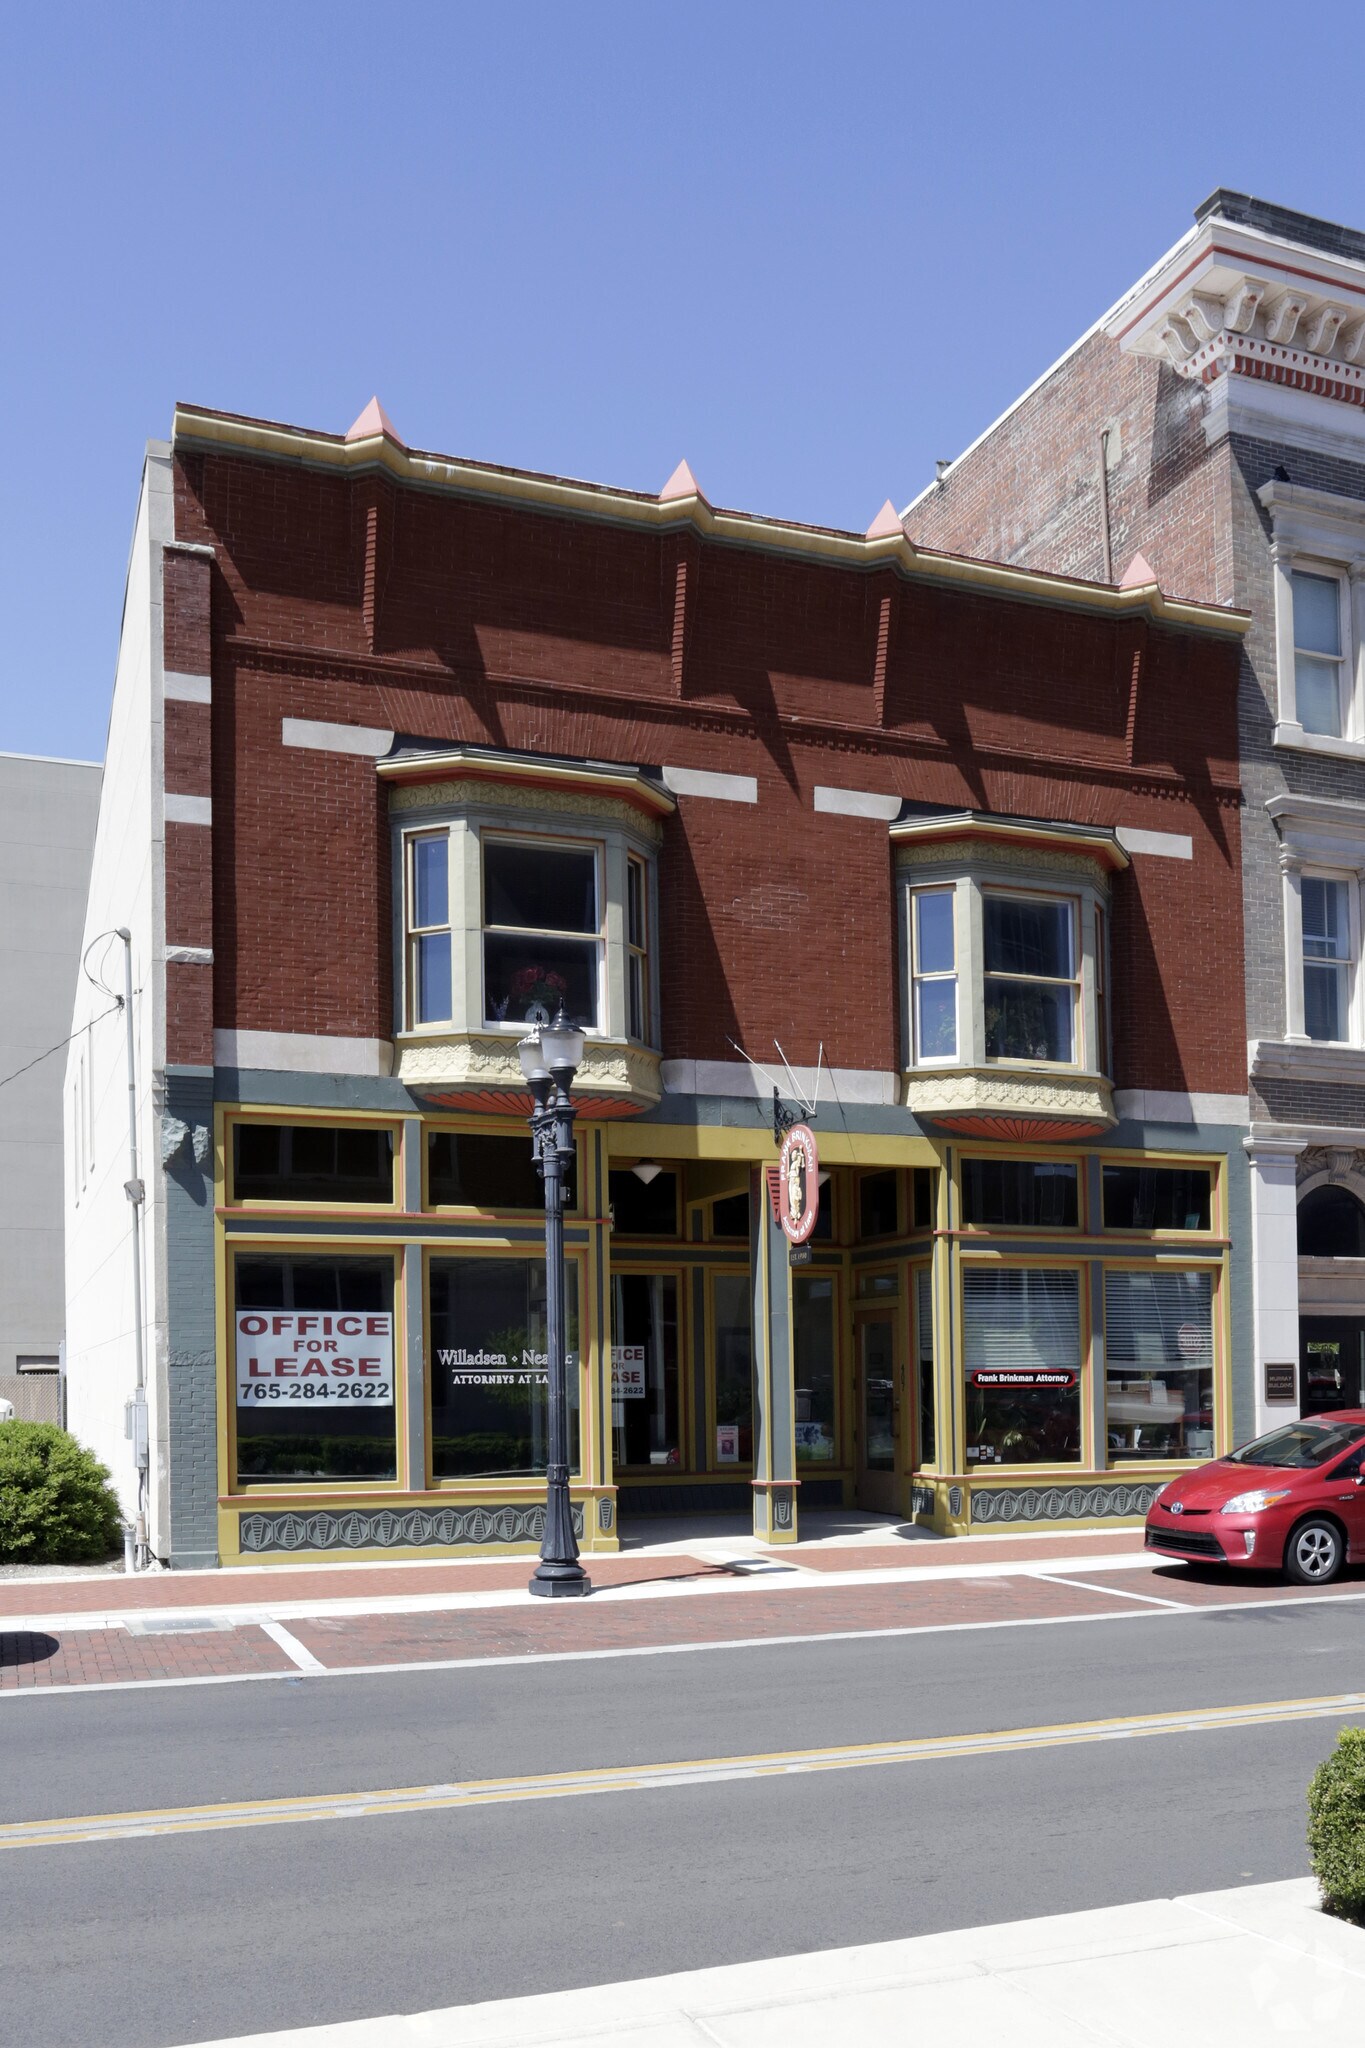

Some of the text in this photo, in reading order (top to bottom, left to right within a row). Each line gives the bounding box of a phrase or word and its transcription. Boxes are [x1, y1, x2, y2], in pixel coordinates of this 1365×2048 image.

[781, 1138, 791, 1180] FRANK
[239, 1316, 389, 1336] OFFICE
[293, 1340, 338, 1352] FOR
[437, 1349, 507, 1365] Willadsen
[611, 1348, 643, 1360] FICE
[249, 1358, 381, 1377] LEASE
[611, 1362, 625, 1370] OR
[453, 1375, 549, 1384] ATTORNEYS AT LA
[611, 1371, 640, 1383] ASE
[978, 1374, 1069, 1383] Frank Brinkman Attorney
[240, 1383, 389, 1399] 765-284-2622
